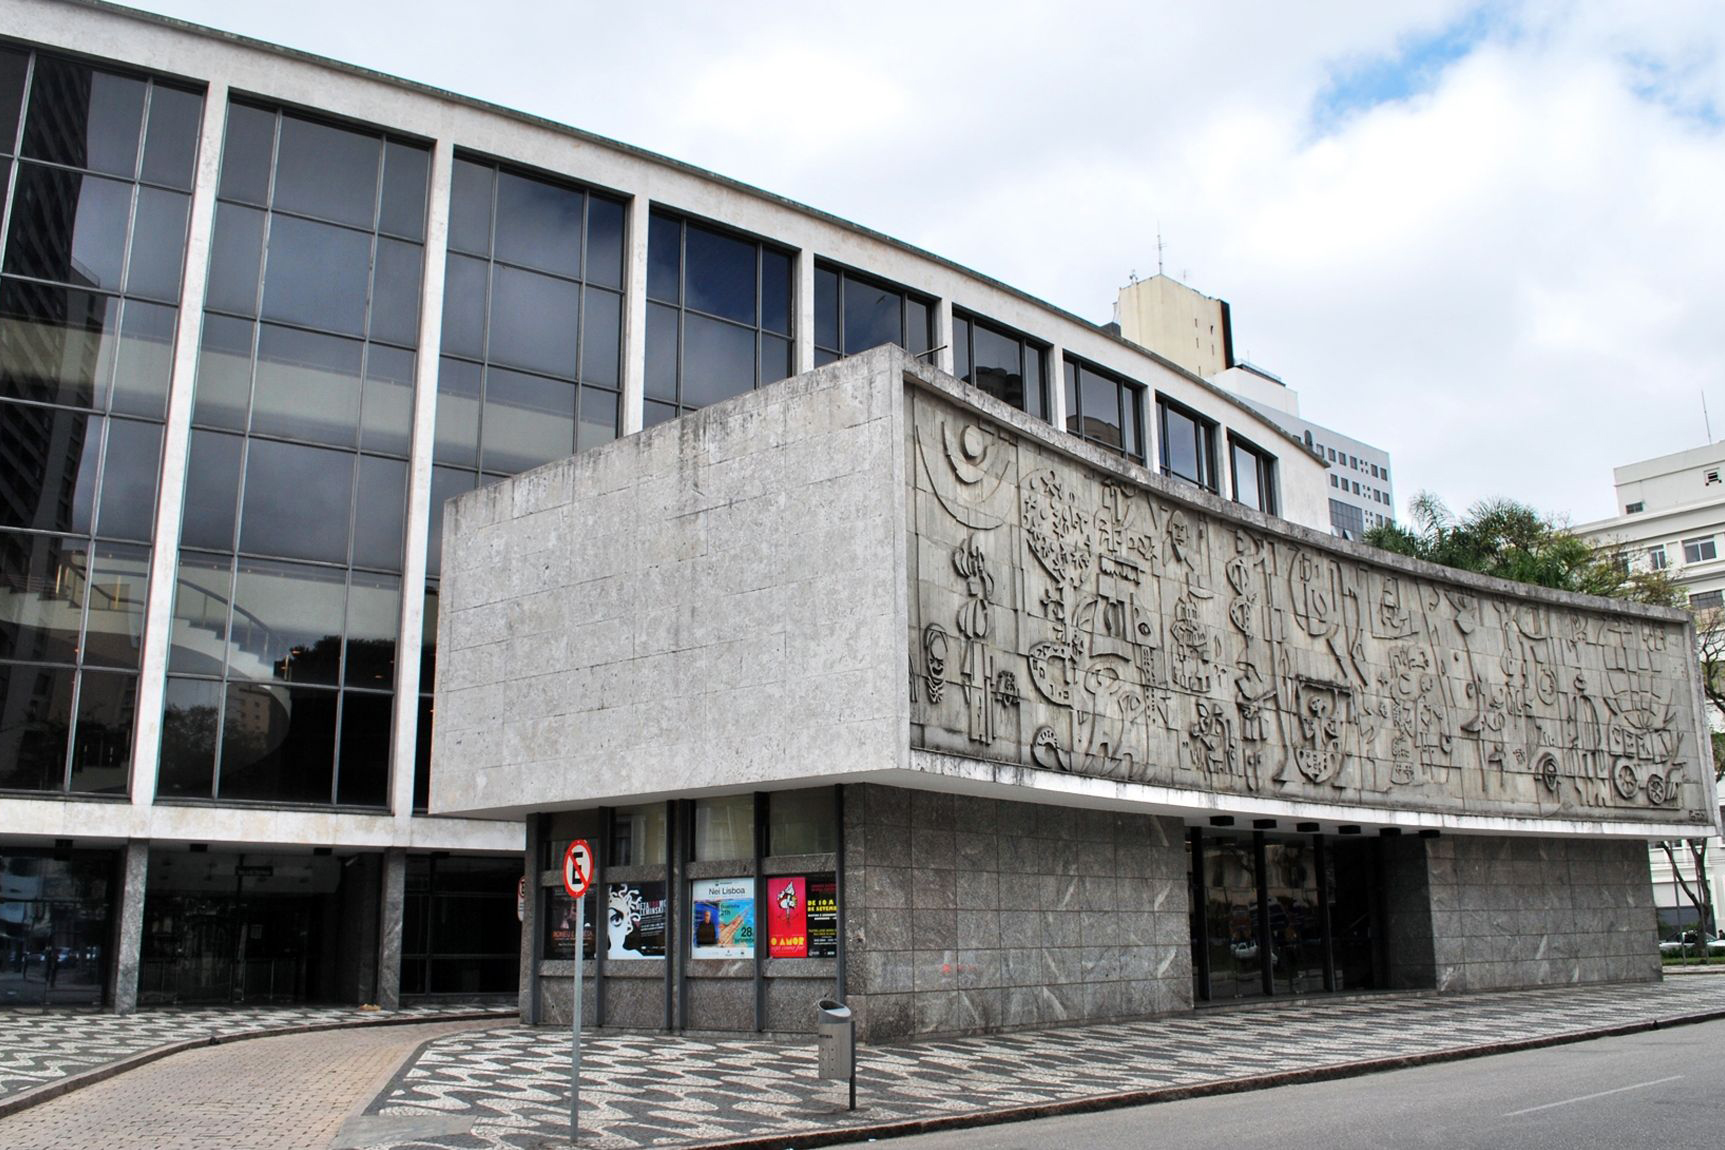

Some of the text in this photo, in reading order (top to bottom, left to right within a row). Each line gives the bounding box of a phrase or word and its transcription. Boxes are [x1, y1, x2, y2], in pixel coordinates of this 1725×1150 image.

[572, 852, 583, 884] E
[708, 887, 746, 895] Nei Lisboa
[741, 926, 753, 937] 28
[770, 936, 804, 946] O AMOR
